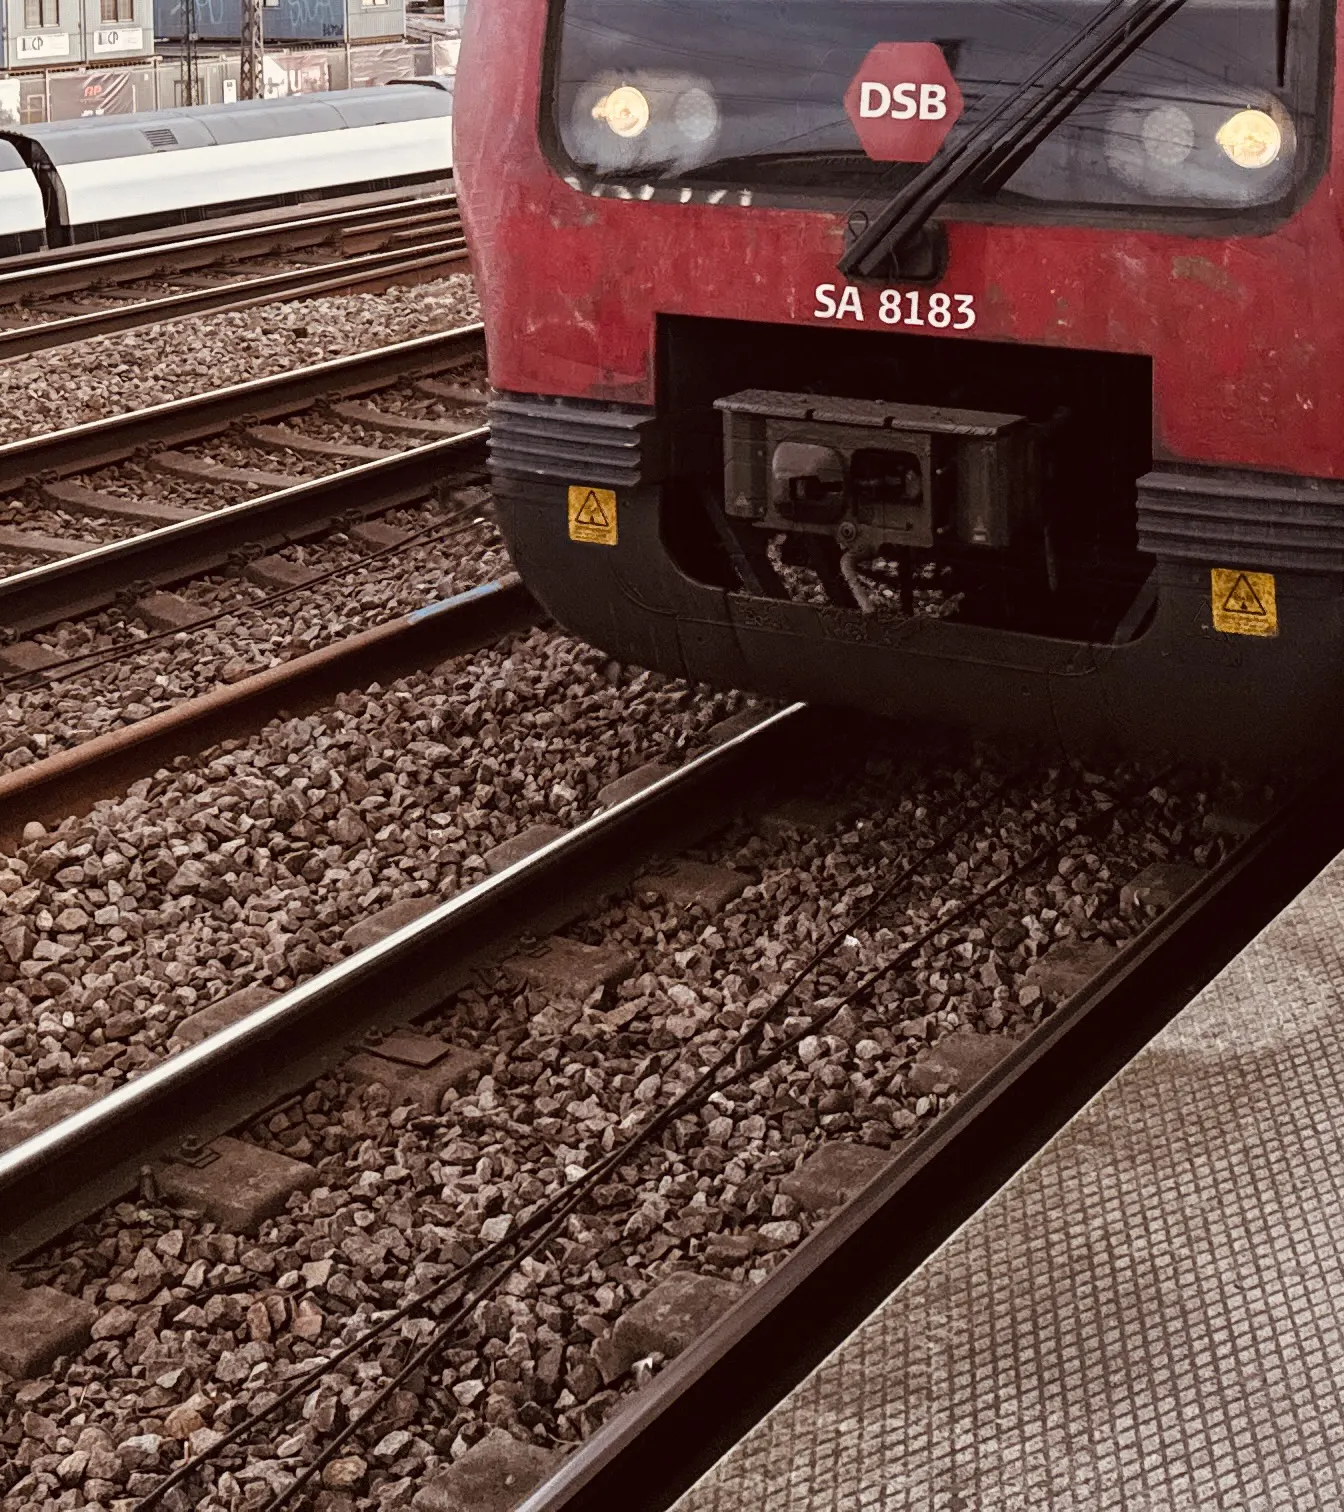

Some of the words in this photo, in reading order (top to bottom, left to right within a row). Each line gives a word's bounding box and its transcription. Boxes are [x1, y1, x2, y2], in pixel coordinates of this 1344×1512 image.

[859, 81, 947, 120] DSB
[814, 283, 864, 322] SA
[878, 289, 976, 330] 8183
